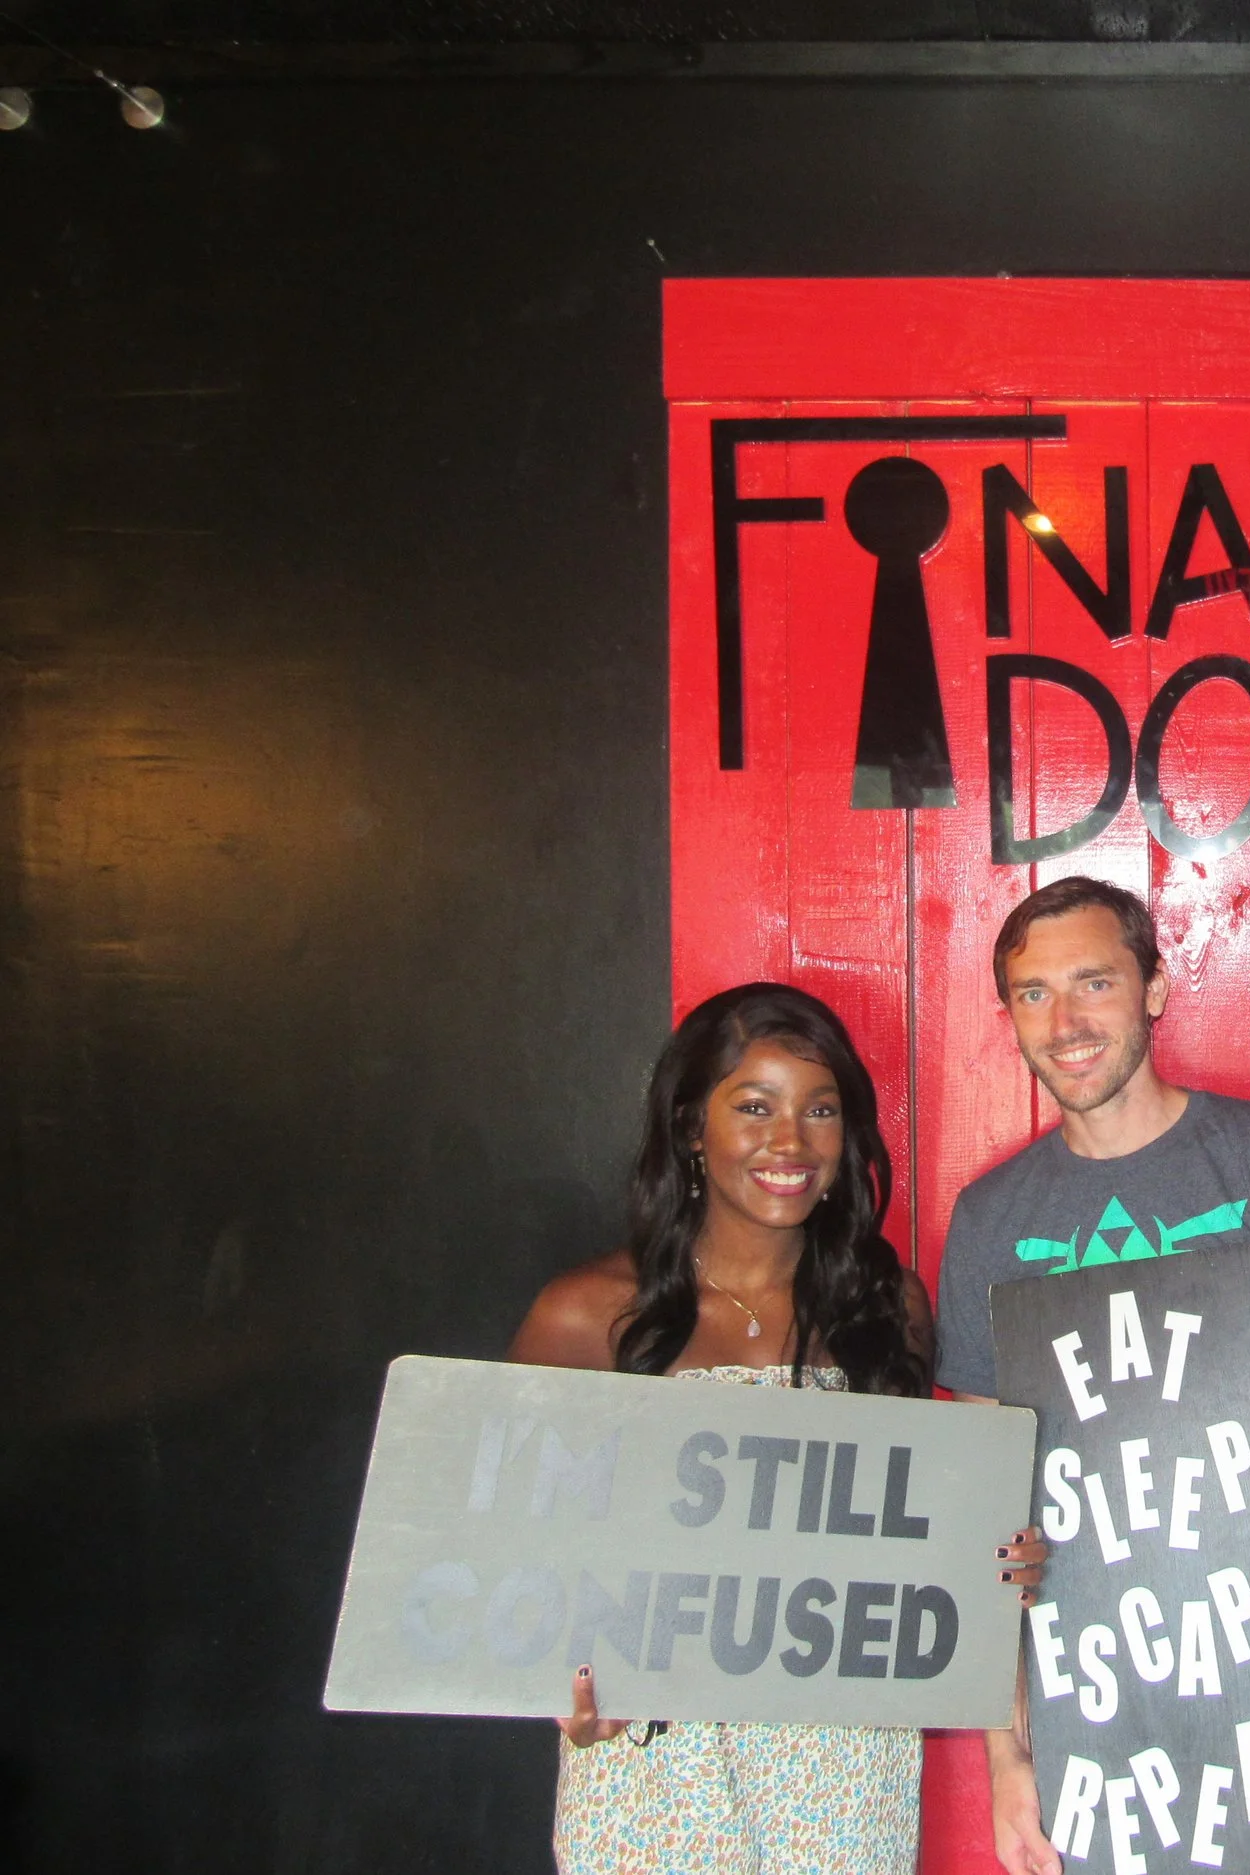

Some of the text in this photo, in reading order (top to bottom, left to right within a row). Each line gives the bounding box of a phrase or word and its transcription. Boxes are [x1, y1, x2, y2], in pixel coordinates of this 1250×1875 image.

[1051, 1291, 1203, 1422] EAT
[467, 1415, 930, 1540] I'M STILL
[400, 1560, 960, 1681] CONFUSED
